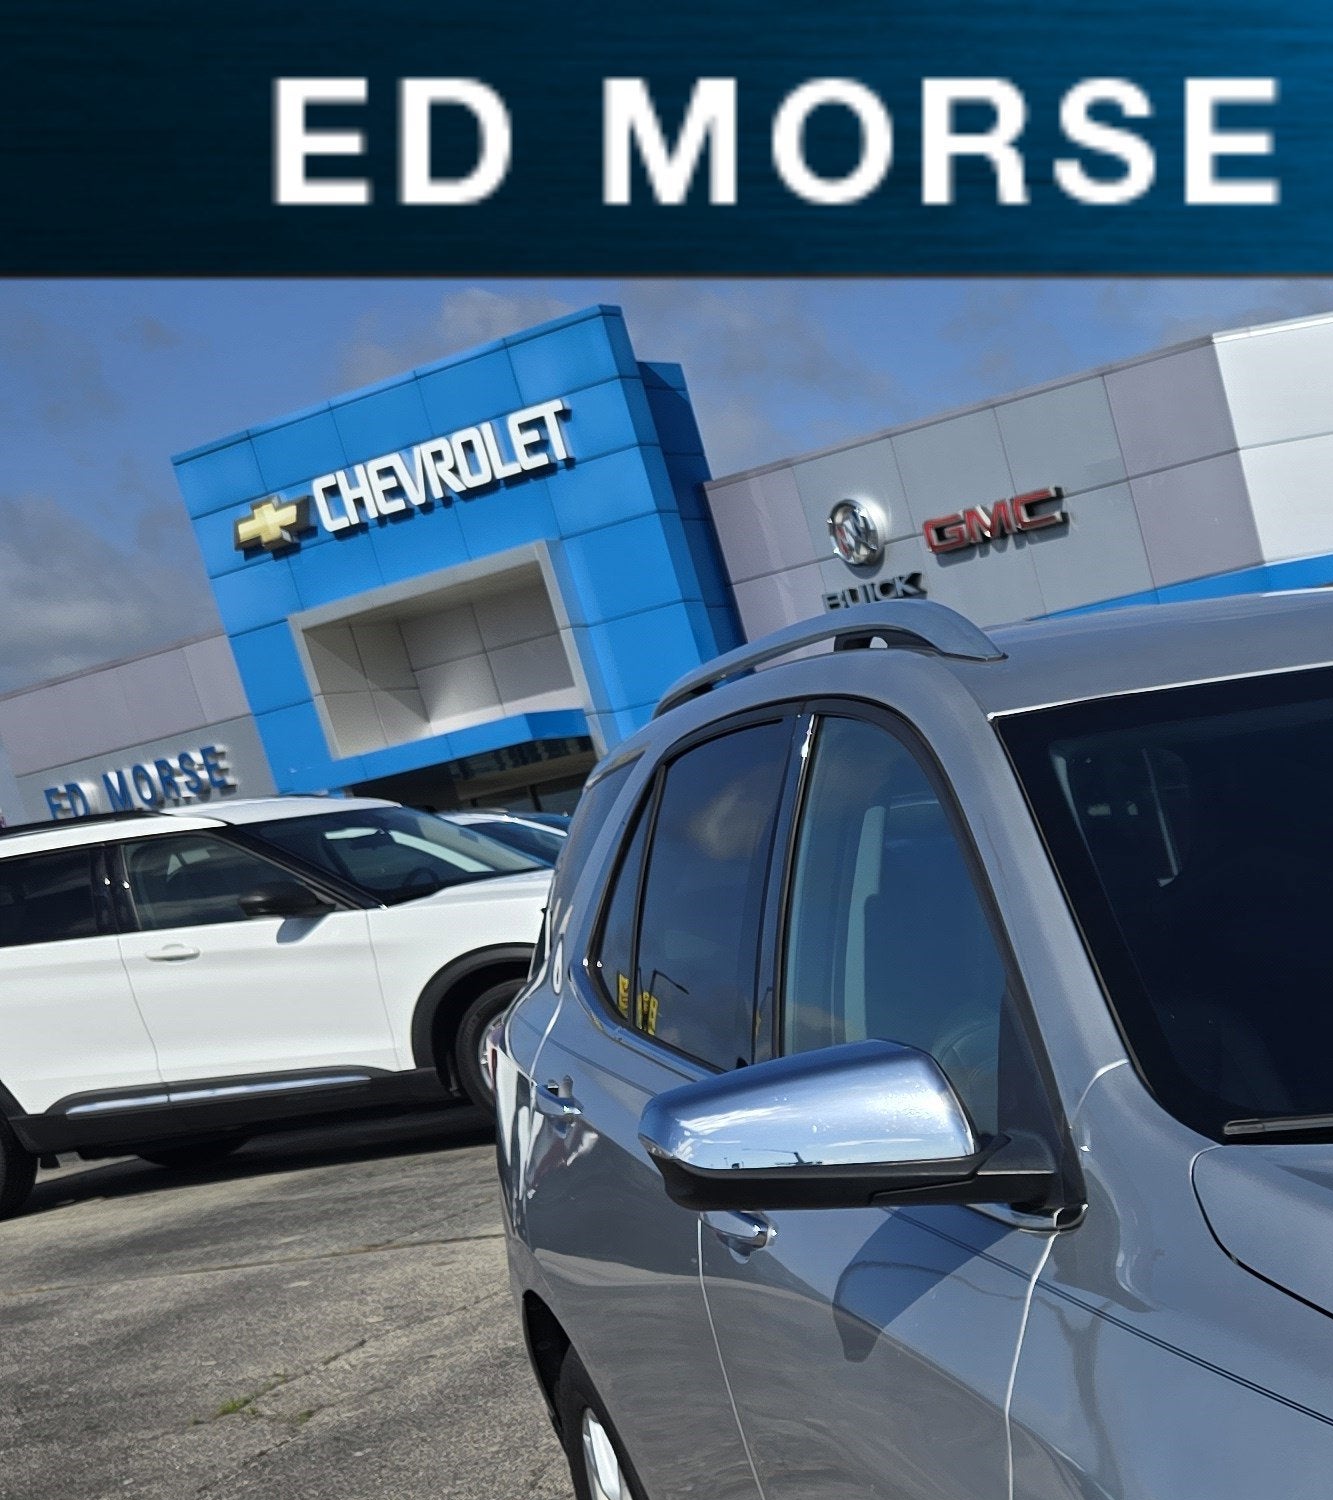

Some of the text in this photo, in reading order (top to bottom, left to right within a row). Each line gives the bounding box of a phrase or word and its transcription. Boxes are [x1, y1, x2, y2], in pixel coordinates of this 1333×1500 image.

[312, 399, 566, 533] CHEVROLET
[923, 486, 1070, 554] GMC
[822, 572, 927, 611] BUICK
[44, 745, 232, 820] ED MORSE
